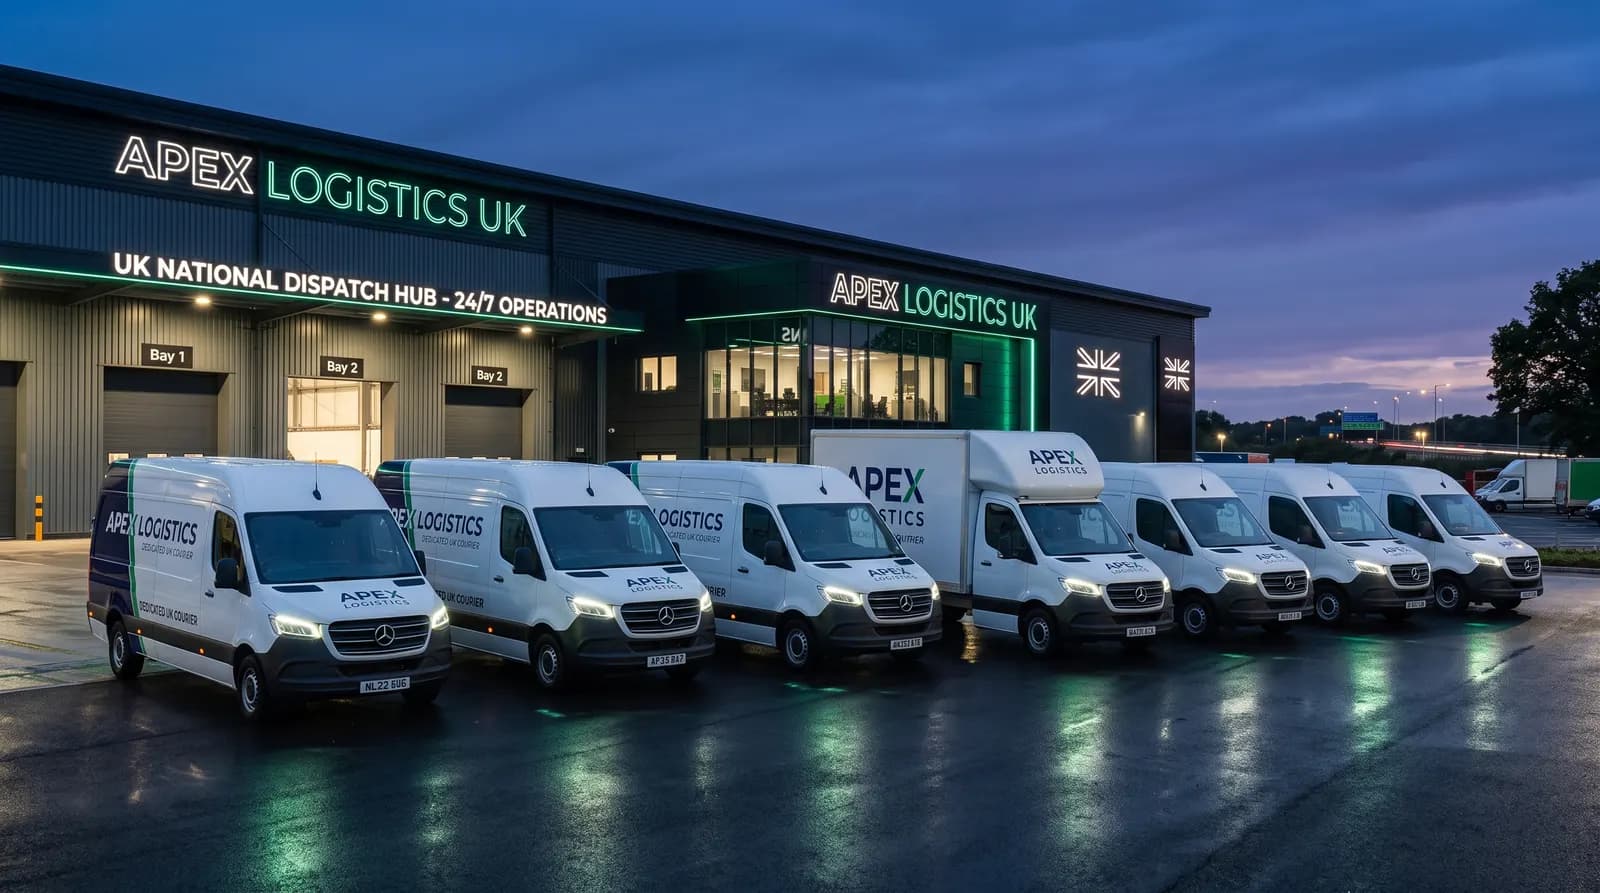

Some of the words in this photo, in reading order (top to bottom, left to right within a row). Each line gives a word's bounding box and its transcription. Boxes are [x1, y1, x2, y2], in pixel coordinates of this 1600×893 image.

[115, 136, 254, 195] APEX
[268, 161, 468, 228] LOGISTICS
[479, 198, 527, 237] UK
[114, 252, 151, 277] UK
[157, 257, 279, 290] NATIONAL
[285, 272, 389, 301] DISPATCH
[394, 284, 437, 306] HUB
[454, 291, 494, 313] 24/7
[499, 296, 607, 324] OPERATIONS
[830, 272, 899, 312] APEX
[904, 283, 1007, 327] LOGISTICS
[1012, 301, 1037, 331] UK
[150, 348, 175, 364] Bay
[178, 350, 185, 363] 1
[327, 360, 348, 375] Bay
[350, 362, 358, 374] 2
[476, 369, 495, 383] Bay
[496, 371, 503, 381] 2
[1029, 449, 1083, 465] APEX
[1034, 466, 1088, 475] LOGISTICS
[392, 507, 416, 529] PEX
[417, 510, 484, 537] LOGISTICS
[653, 508, 724, 531] OGISTICS
[105, 511, 138, 536] APEX
[138, 515, 198, 545] LOGISTICS
[868, 567, 911, 577] APEX
[626, 576, 677, 588] APEX
[631, 584, 683, 593] LOGISTICS
[341, 590, 405, 603] APEX
[344, 599, 410, 609] LOGISTICS
[139, 600, 166, 616] DEDICATED
[166, 607, 173, 620] UK
[174, 610, 198, 625] COURIER
